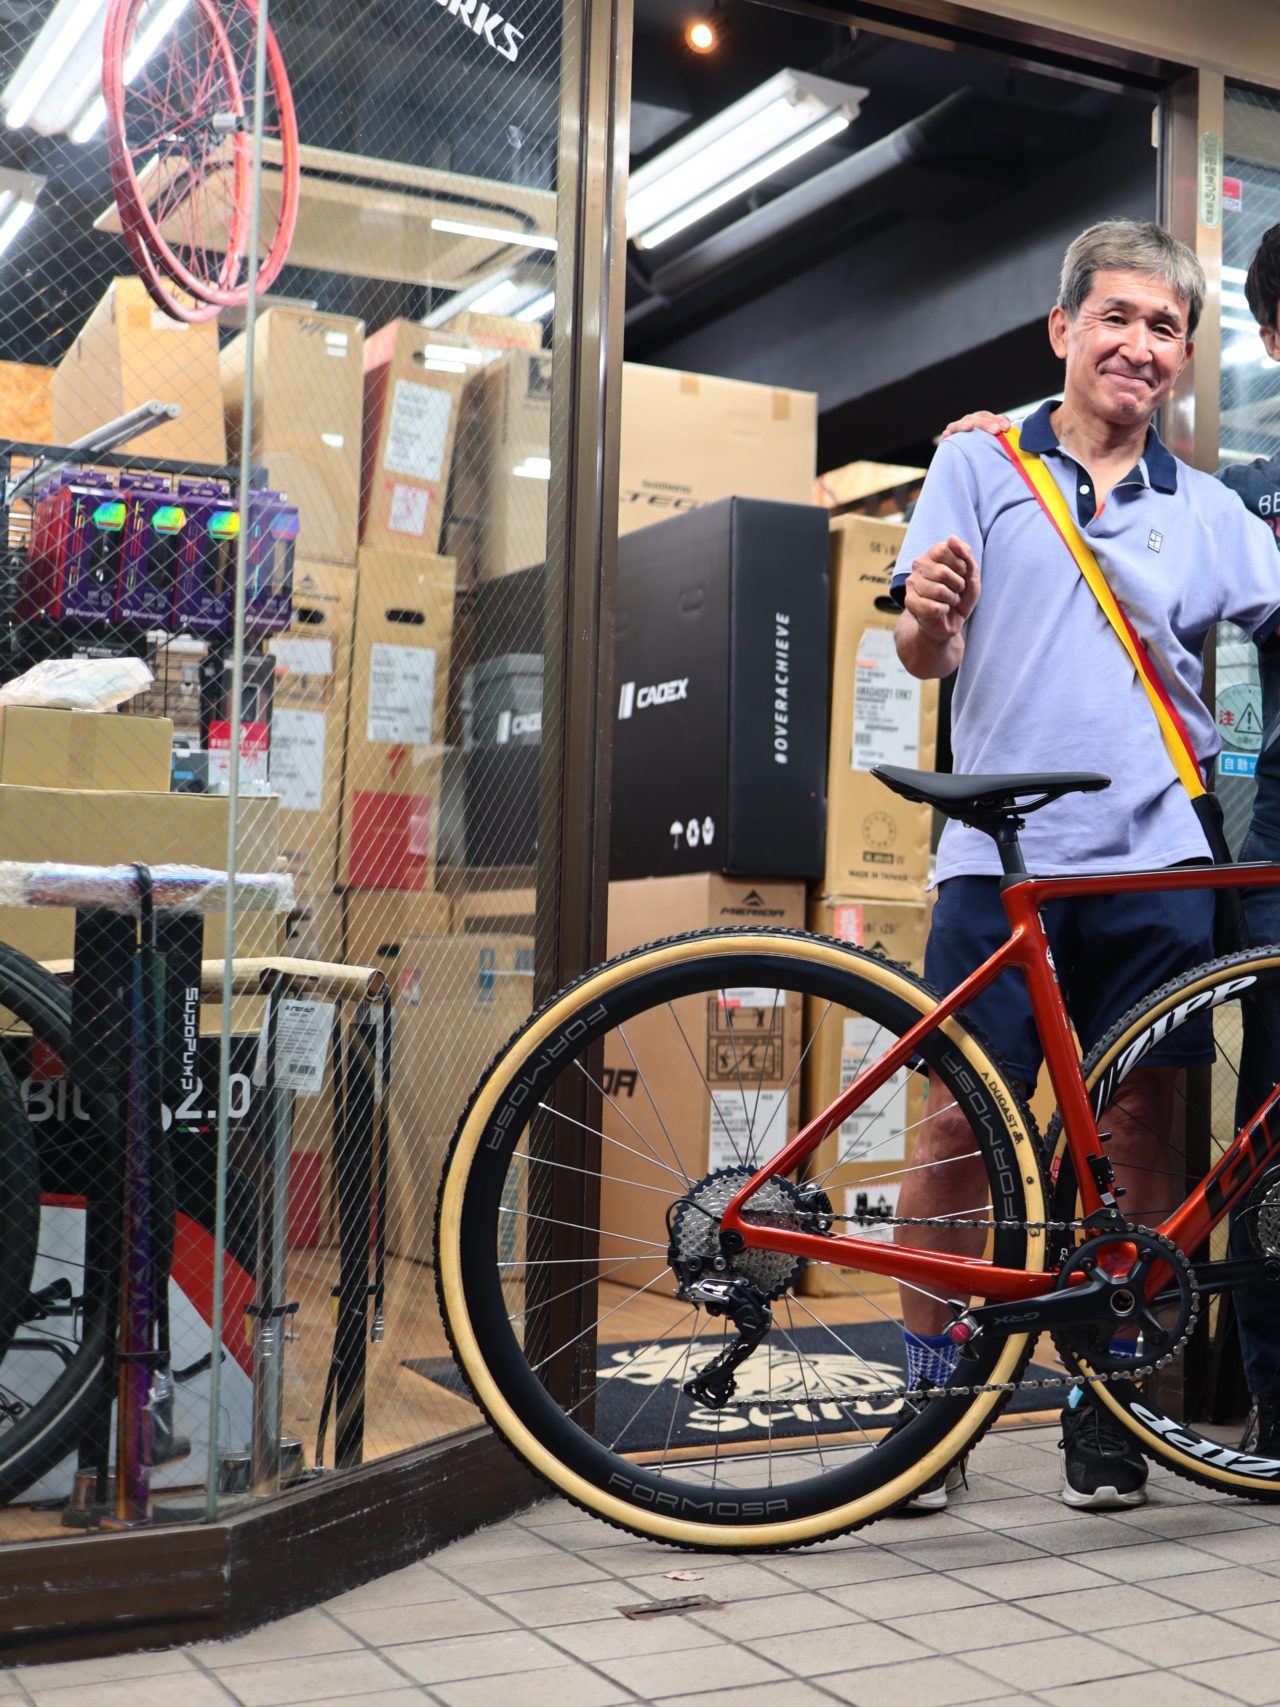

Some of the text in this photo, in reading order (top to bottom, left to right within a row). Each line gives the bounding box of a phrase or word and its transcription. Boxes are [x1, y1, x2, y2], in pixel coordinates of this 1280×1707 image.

[435, 0, 525, 62] RKS
[636, 677, 690, 709] CADEX
[1219, 709, 1235, 727] 注
[1117, 975, 1257, 1084] ZIPP
[174, 1073, 250, 1120] 2.0
[485, 1003, 608, 1151] FORMOSA
[980, 1071, 1019, 1130] A DUGAST
[940, 1051, 1018, 1220] FORMOSA
[608, 1471, 790, 1517] FORMOSA
